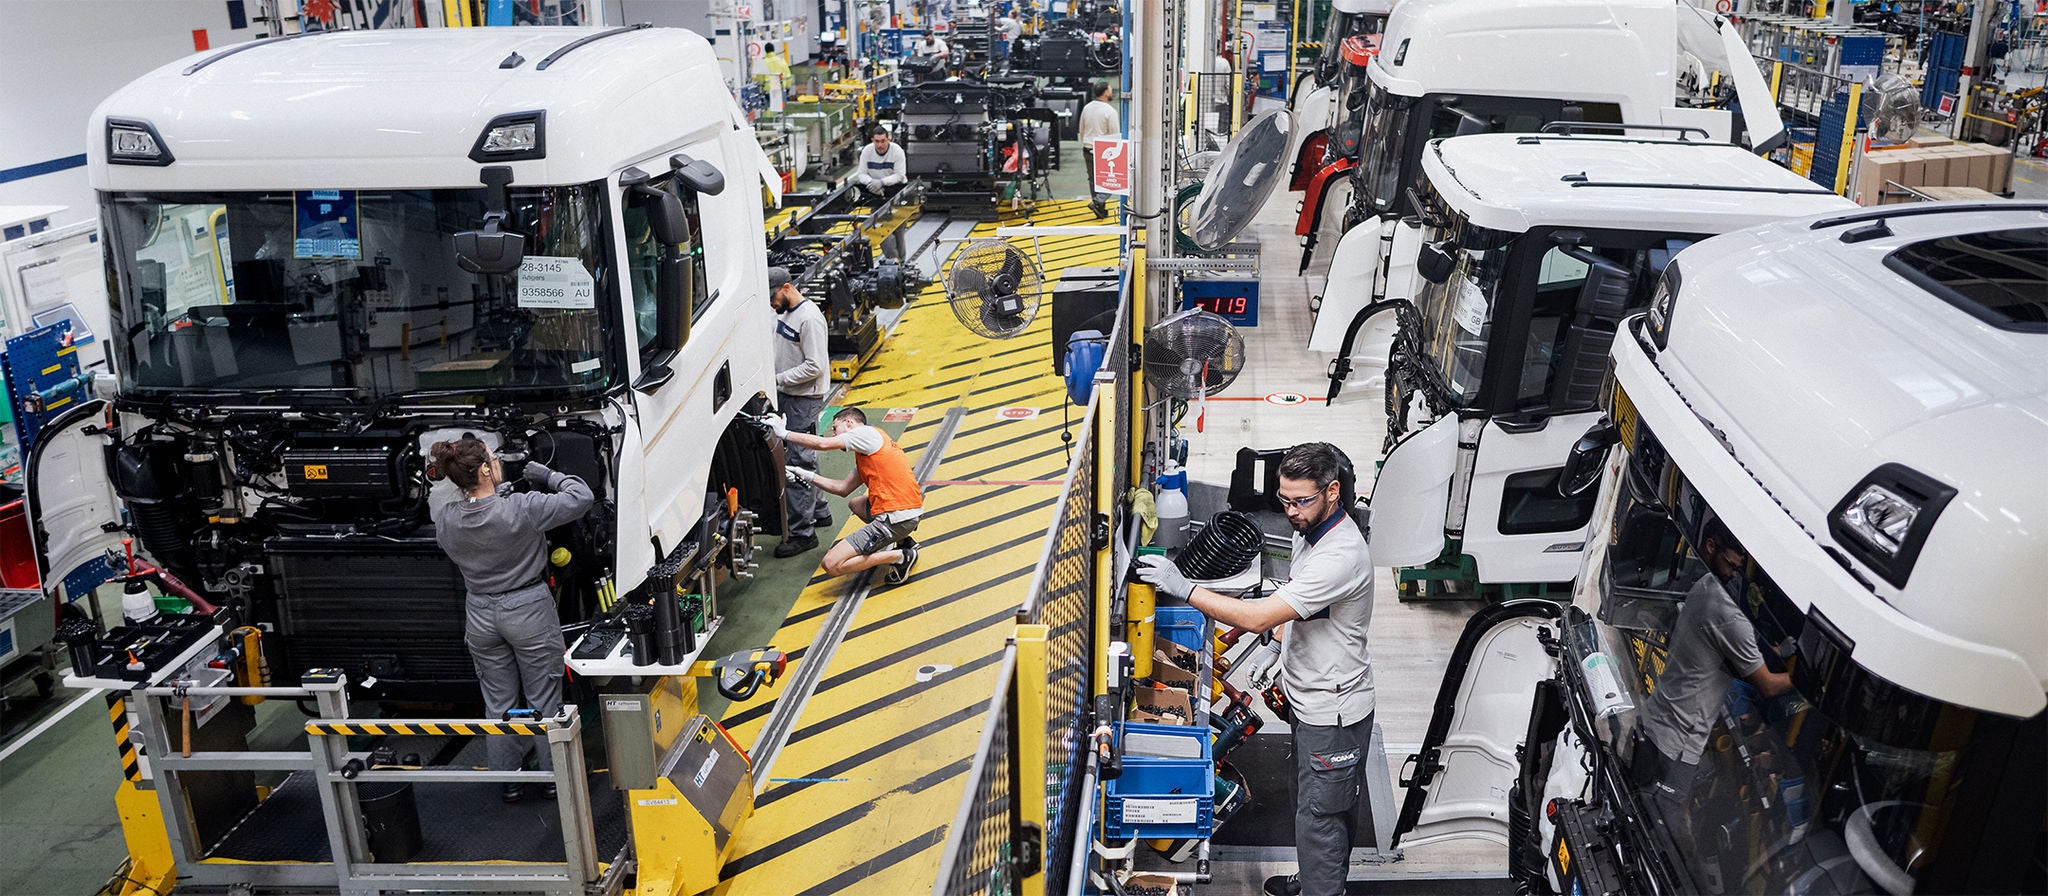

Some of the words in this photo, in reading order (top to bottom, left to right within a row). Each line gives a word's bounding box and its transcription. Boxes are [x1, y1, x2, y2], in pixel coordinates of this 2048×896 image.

[521, 263, 562, 273] 28-3145
[521, 287, 565, 298] 9358566
[574, 288, 591, 298] AU
[1471, 315, 1481, 326] GB
[695, 771, 705, 786] HT
